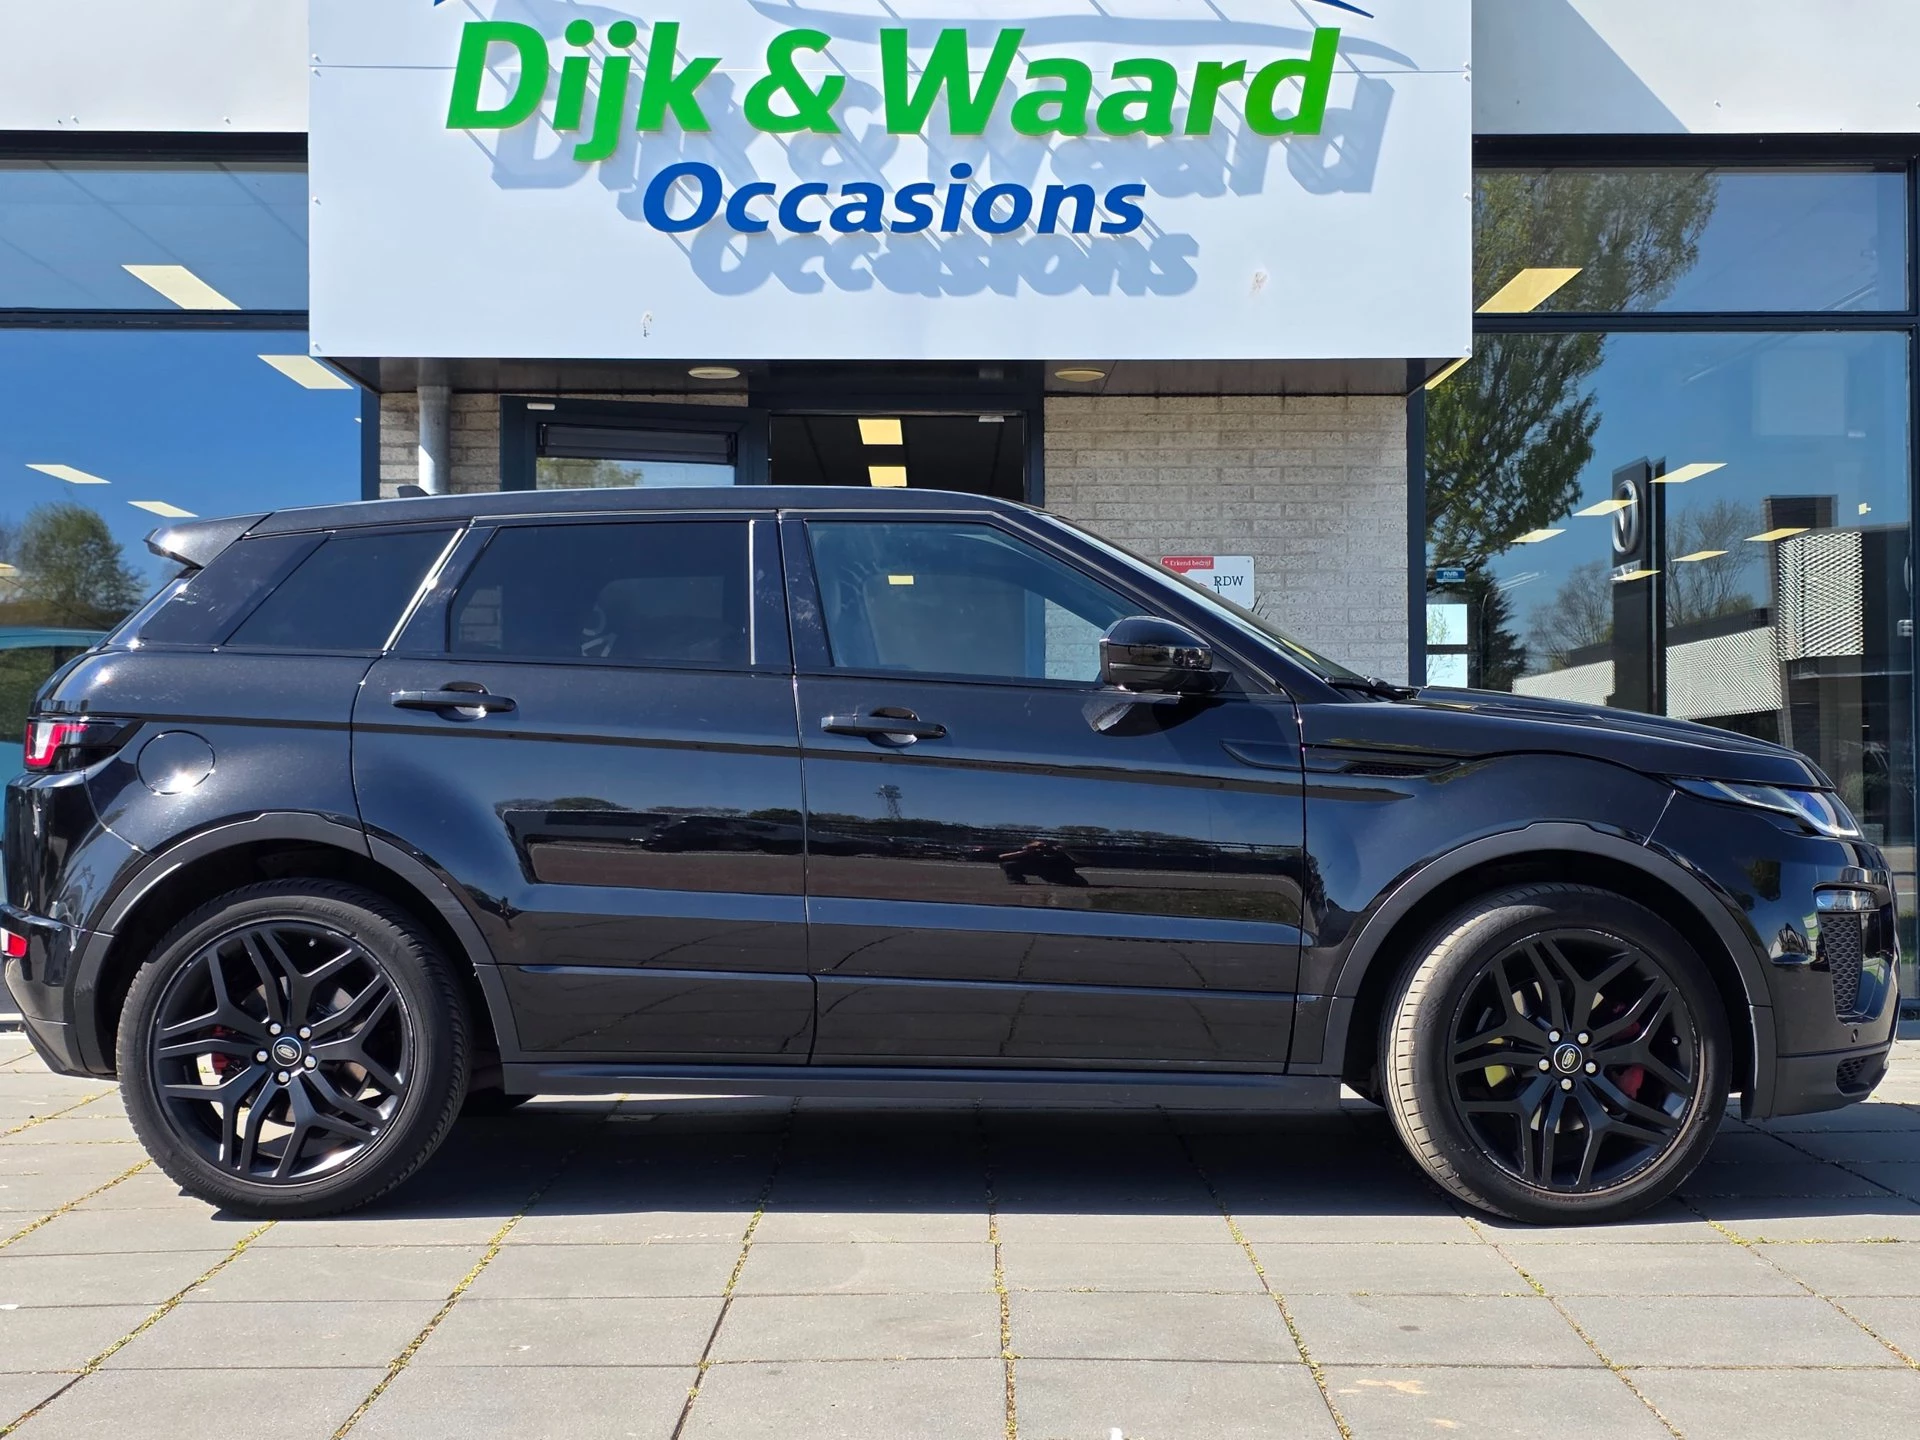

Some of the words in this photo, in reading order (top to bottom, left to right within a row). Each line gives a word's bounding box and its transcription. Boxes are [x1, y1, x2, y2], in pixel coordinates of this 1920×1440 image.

[446, 19, 720, 161] Dijk
[744, 28, 847, 133] &
[880, 27, 1340, 136] Waard
[642, 161, 1147, 235] Occasions
[1213, 575, 1244, 587] RDW
